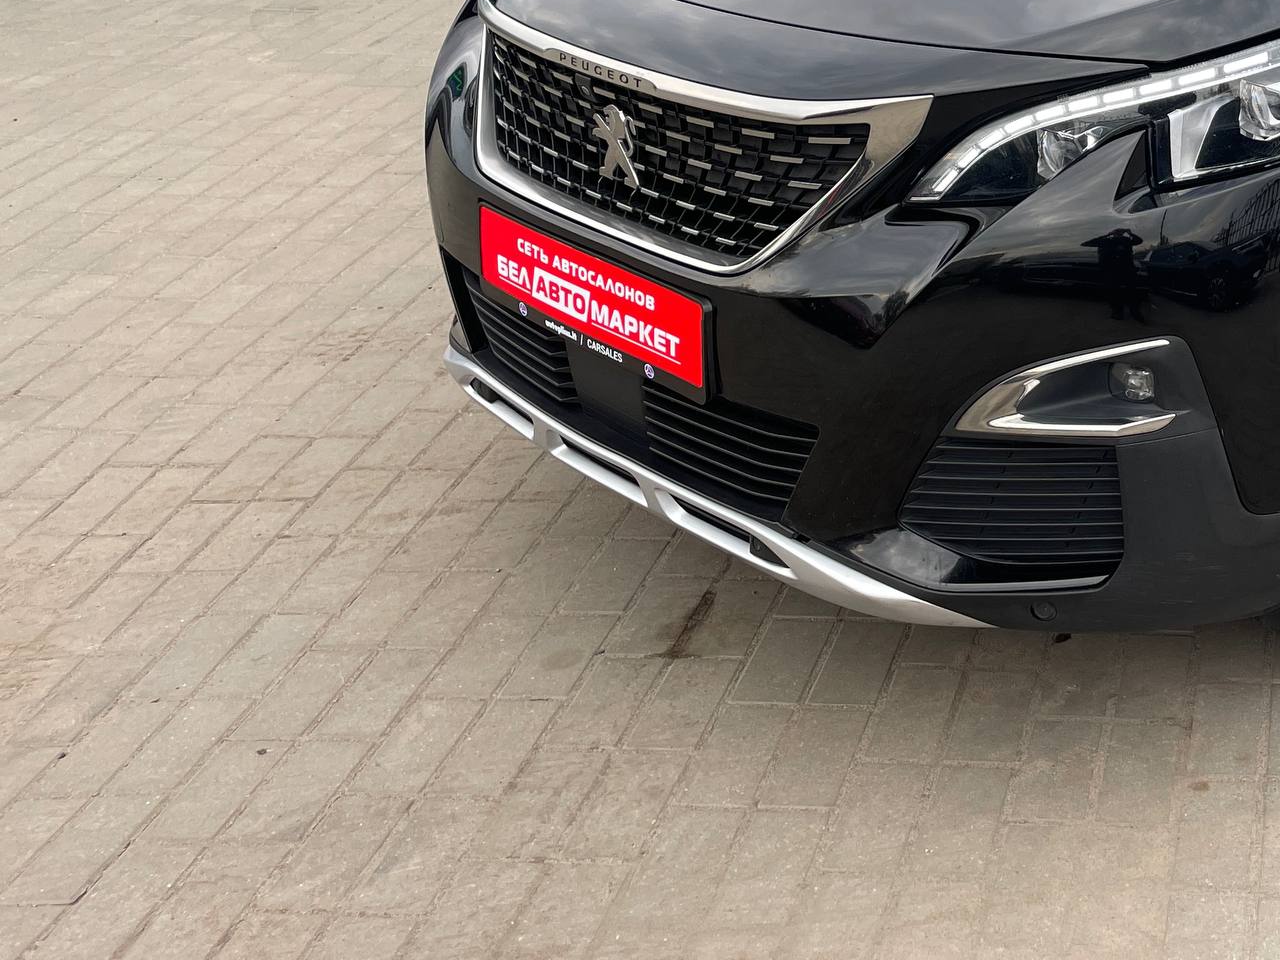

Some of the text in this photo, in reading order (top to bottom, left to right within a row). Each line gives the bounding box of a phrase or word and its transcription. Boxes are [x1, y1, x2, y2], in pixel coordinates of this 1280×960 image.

[559, 52, 642, 88] PEUGEOT
[517, 238, 656, 311] СЕТЬ АВТОСАЛОНОВ
[497, 254, 681, 358] БЕЛ АВТО МАРКЕТ
[586, 338, 623, 363] CARSALES
